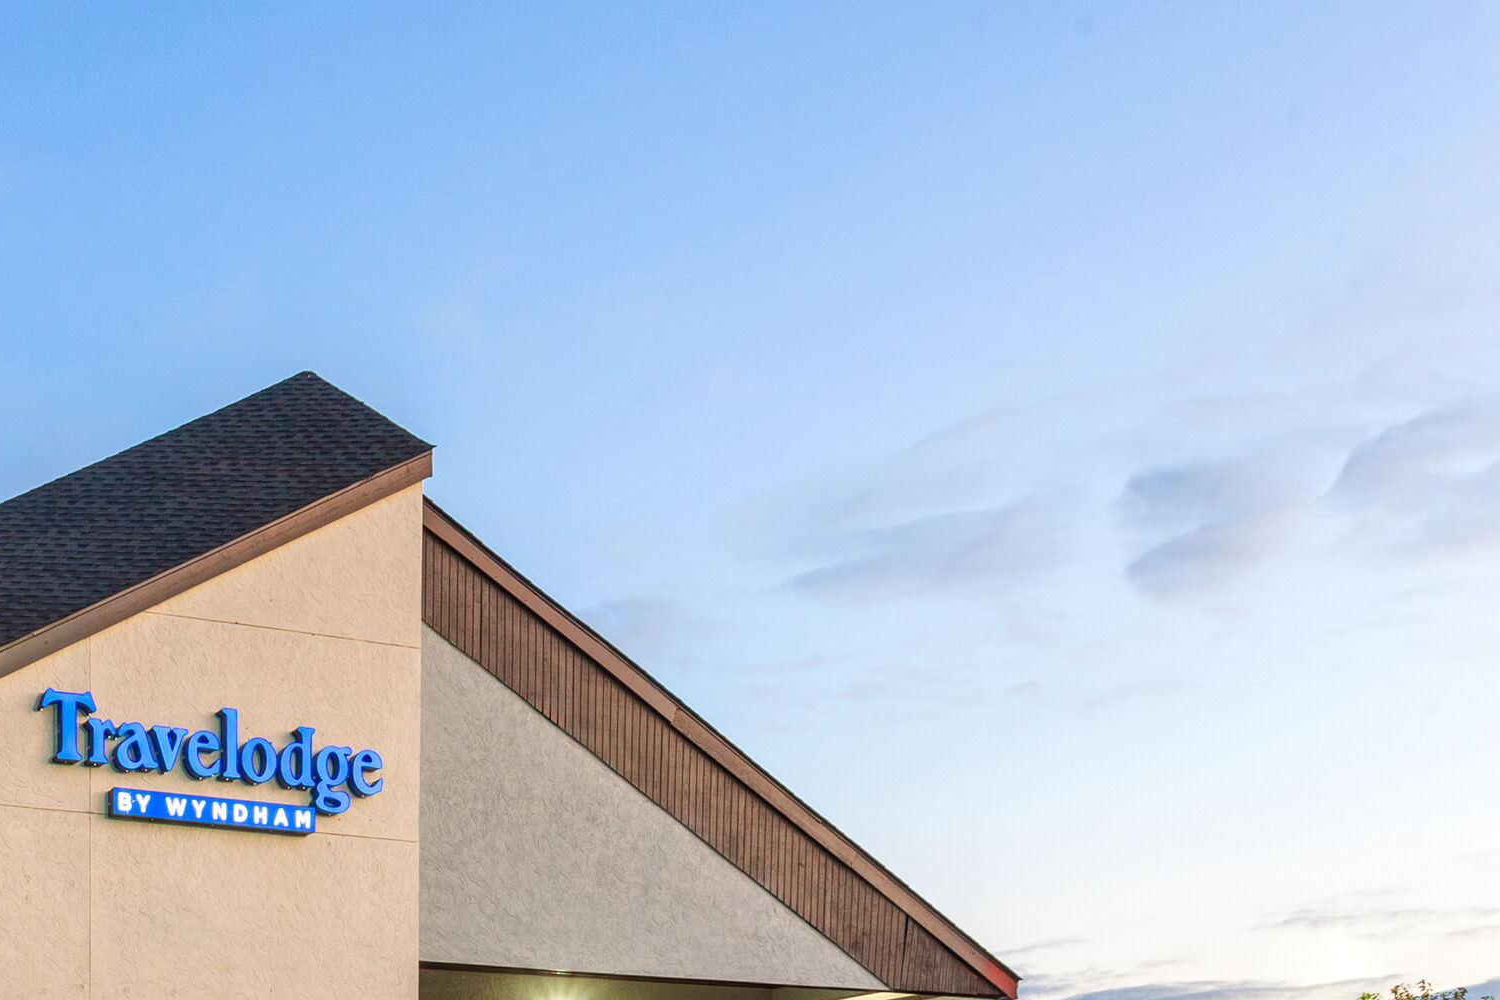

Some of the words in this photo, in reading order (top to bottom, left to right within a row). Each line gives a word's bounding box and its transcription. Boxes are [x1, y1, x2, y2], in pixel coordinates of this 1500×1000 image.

[40, 687, 383, 815] Travelodge
[117, 792, 151, 813] BY
[165, 796, 312, 829] WYNDHAM
